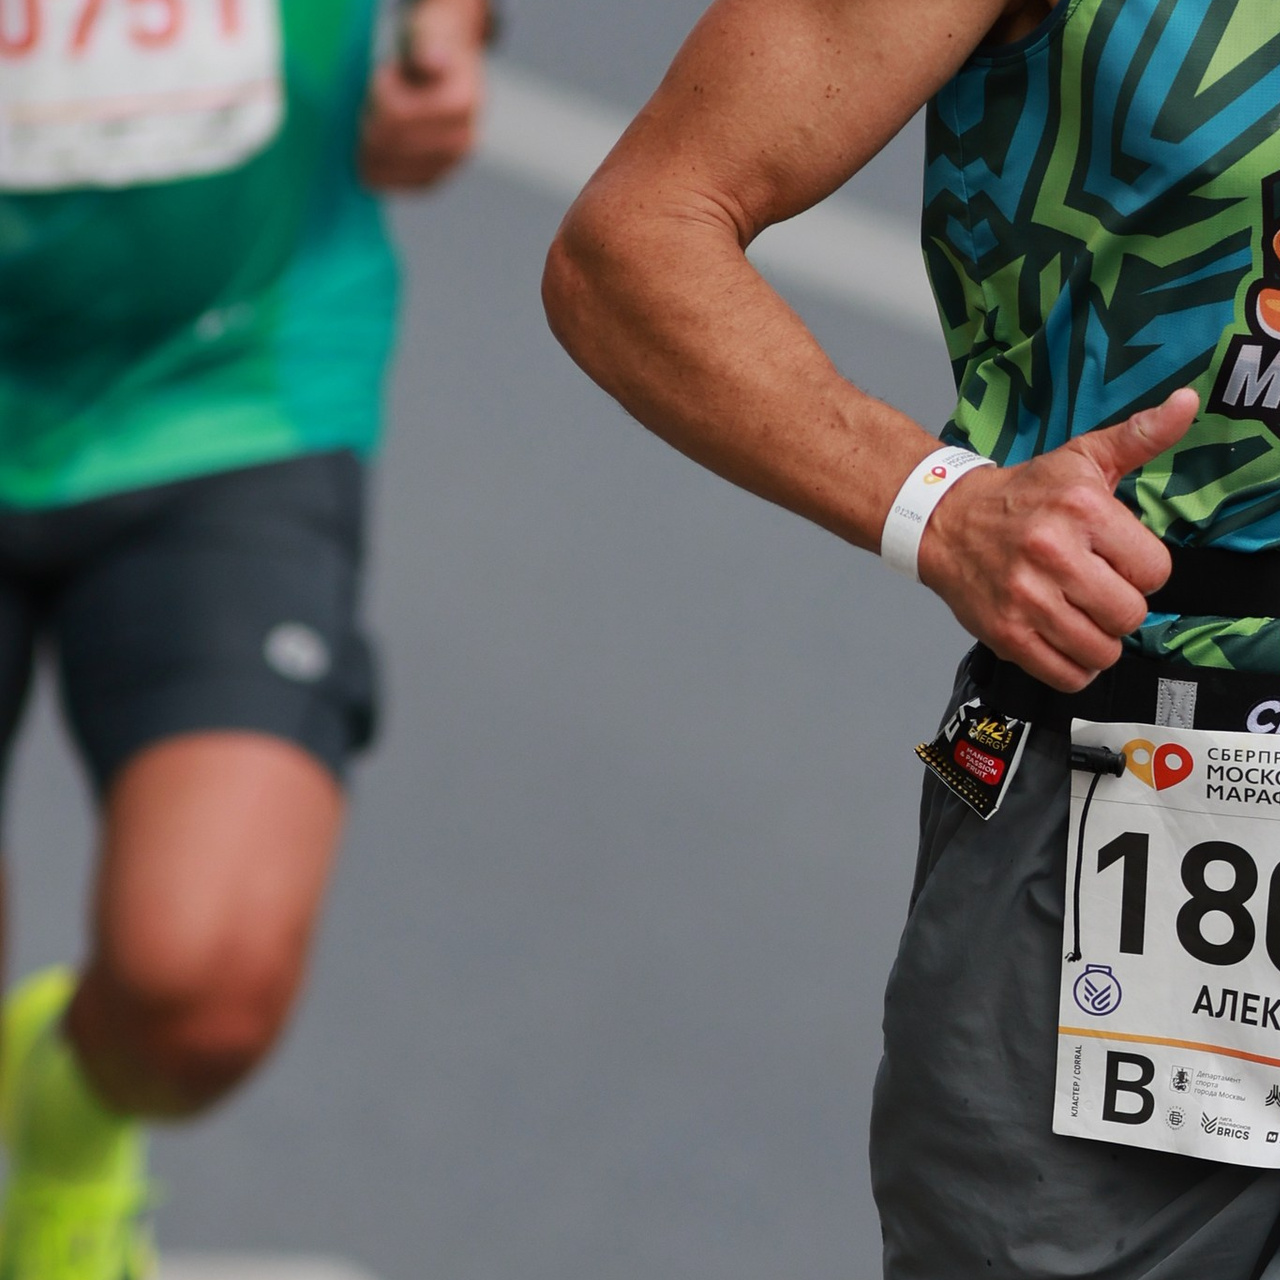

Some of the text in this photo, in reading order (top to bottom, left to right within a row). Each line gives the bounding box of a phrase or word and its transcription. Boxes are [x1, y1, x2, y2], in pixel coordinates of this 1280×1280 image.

[968, 727, 1008, 751] ENERGY
[966, 747, 995, 766] MANGO
[966, 754, 998, 776] PASSION
[966, 763, 988, 779] FRUIT
[1073, 1045, 1082, 1075] CORRAL
[1195, 1079, 1219, 1089] спорта
[1196, 1070, 1242, 1084] Департамент
[1102, 1050, 1156, 1125] B
[1193, 1087, 1246, 1101] города Москвы
[1071, 1081, 1080, 1118] КЛАСТЕР
[1216, 1126, 1250, 1141] BRICS
